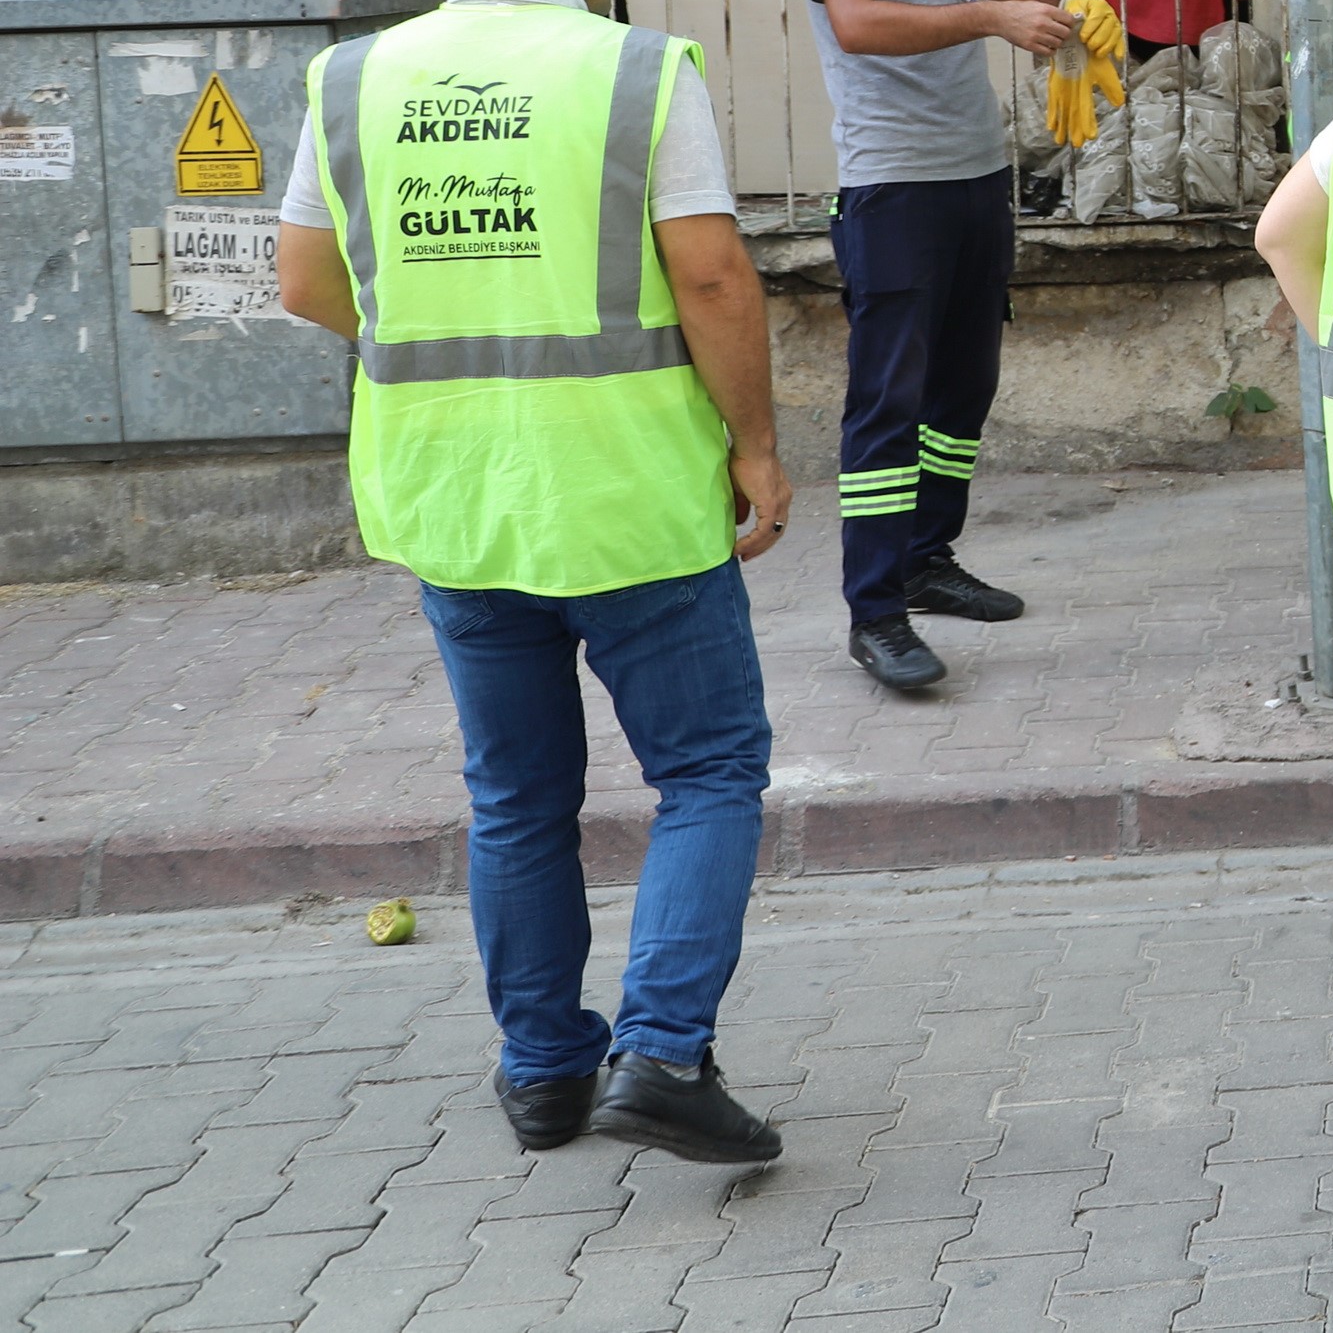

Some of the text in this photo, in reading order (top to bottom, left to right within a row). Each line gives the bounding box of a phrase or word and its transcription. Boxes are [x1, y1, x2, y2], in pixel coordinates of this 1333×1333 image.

[403, 96, 533, 118] SEVDAMIZ
[396, 116, 531, 143] AKDENİZ
[174, 211, 206, 223] TARIK
[209, 213, 236, 225] USTA
[240, 216, 250, 224] ve
[400, 207, 538, 236] GÜLTAK
[174, 227, 236, 260] LAĞAM
[403, 242, 446, 256] AKDENİZ
[448, 240, 497, 254] BELEDİYE
